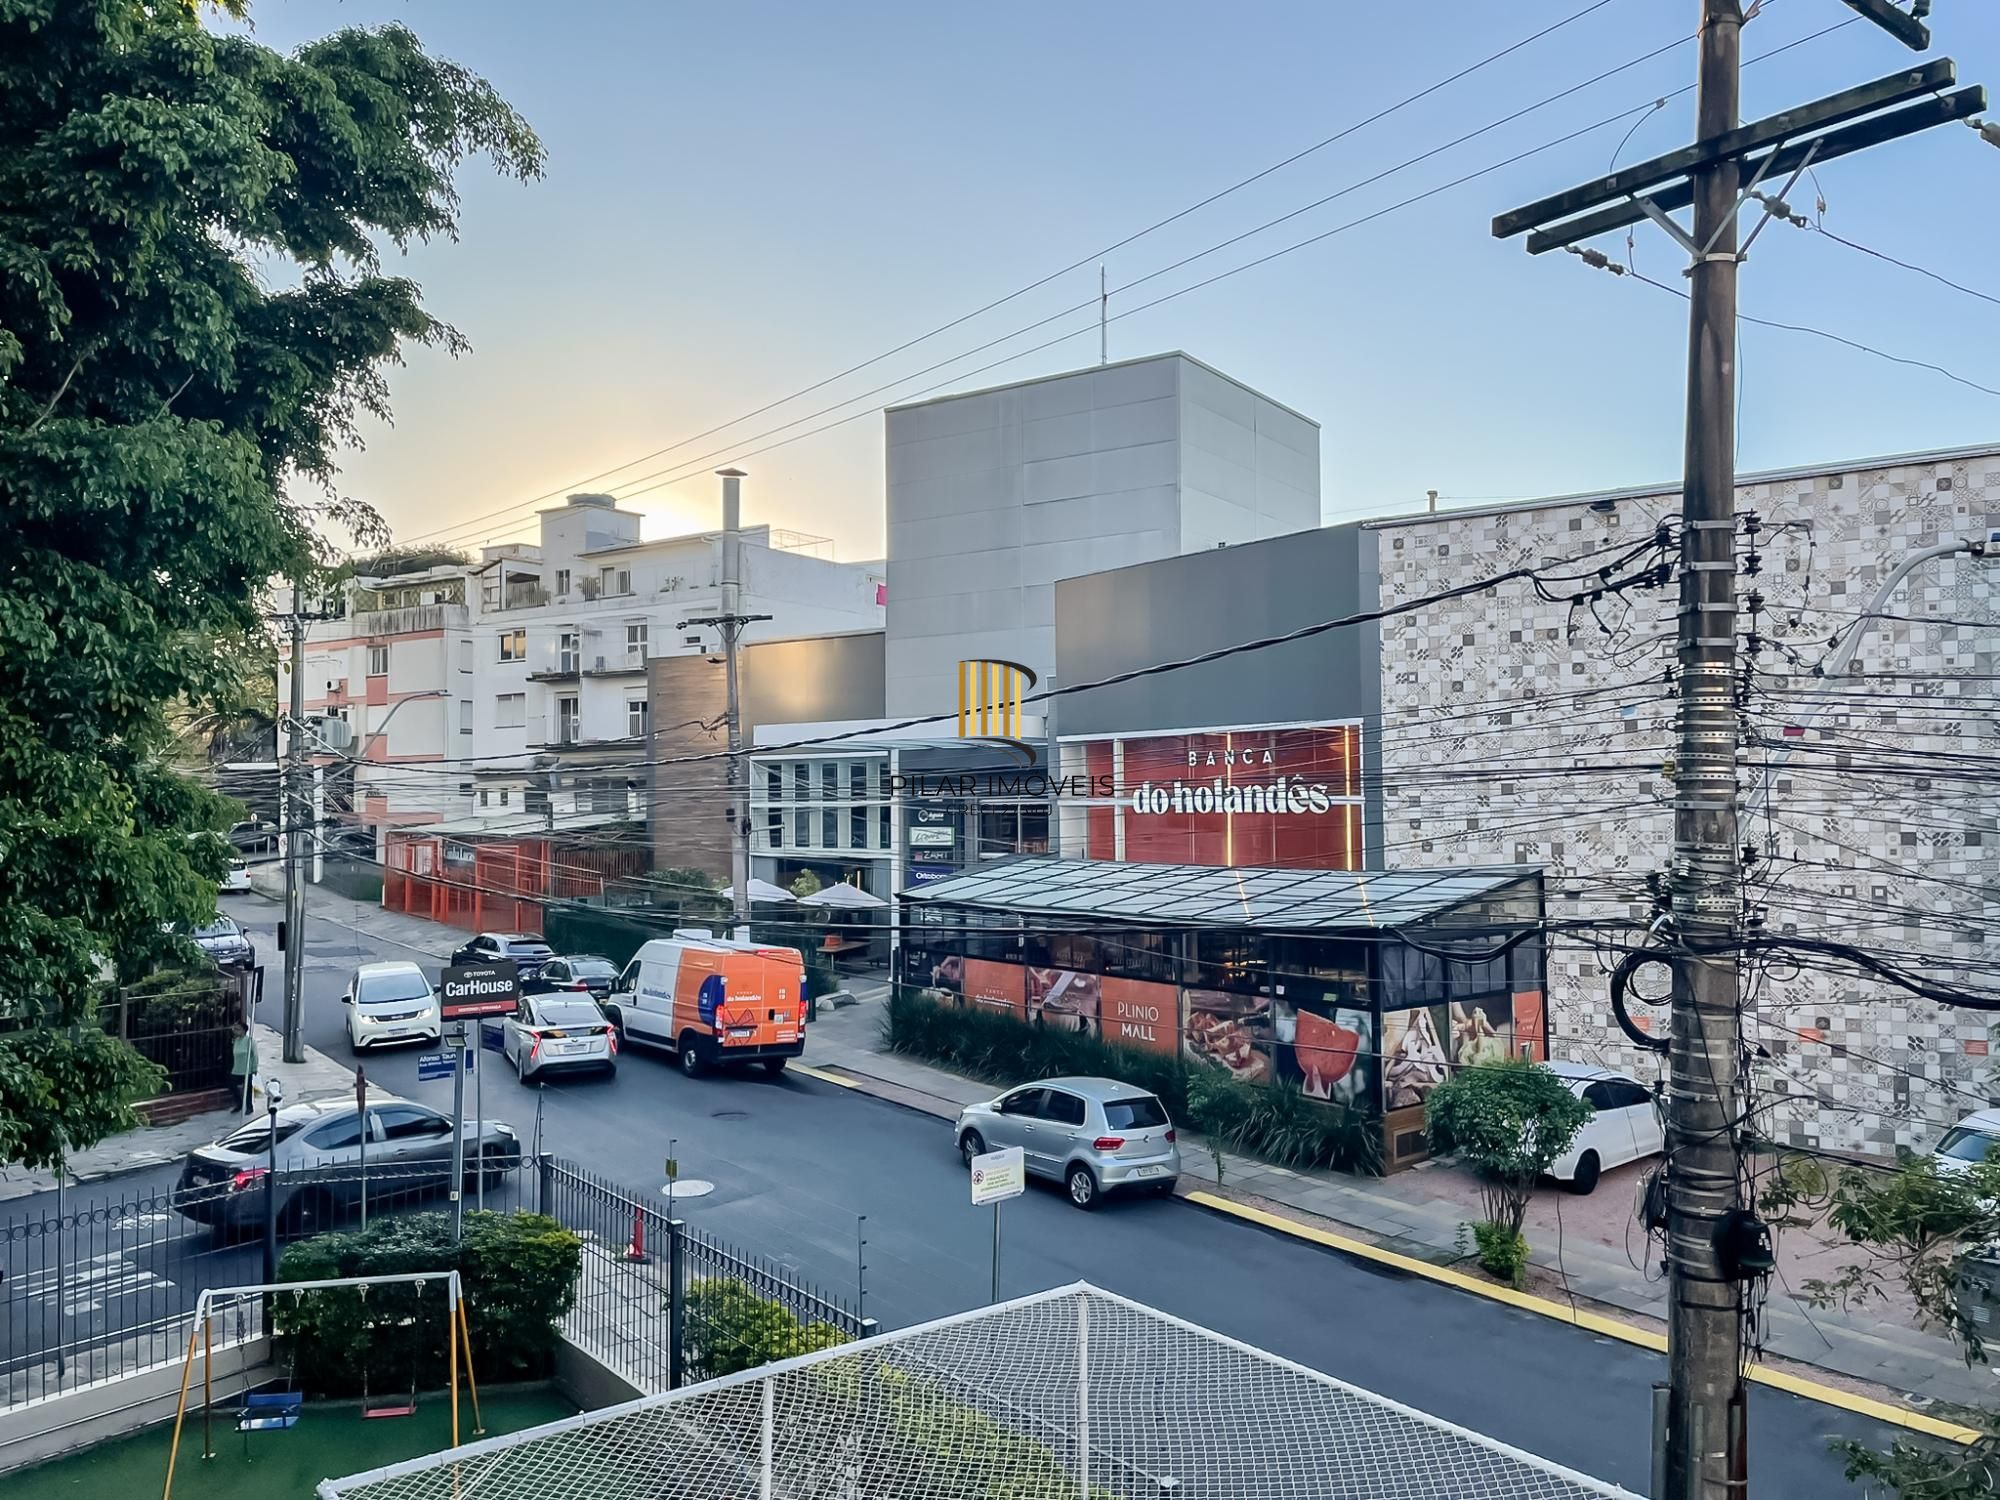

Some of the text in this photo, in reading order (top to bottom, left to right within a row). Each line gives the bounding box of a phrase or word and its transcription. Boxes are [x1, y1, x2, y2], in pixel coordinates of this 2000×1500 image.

[1188, 748, 1272, 766] BANCA
[1133, 774, 1330, 814] do holandês
[445, 979, 513, 997] CarHouse
[1117, 1001, 1159, 1022] PLINIO
[1121, 1022, 1156, 1042] MALL
